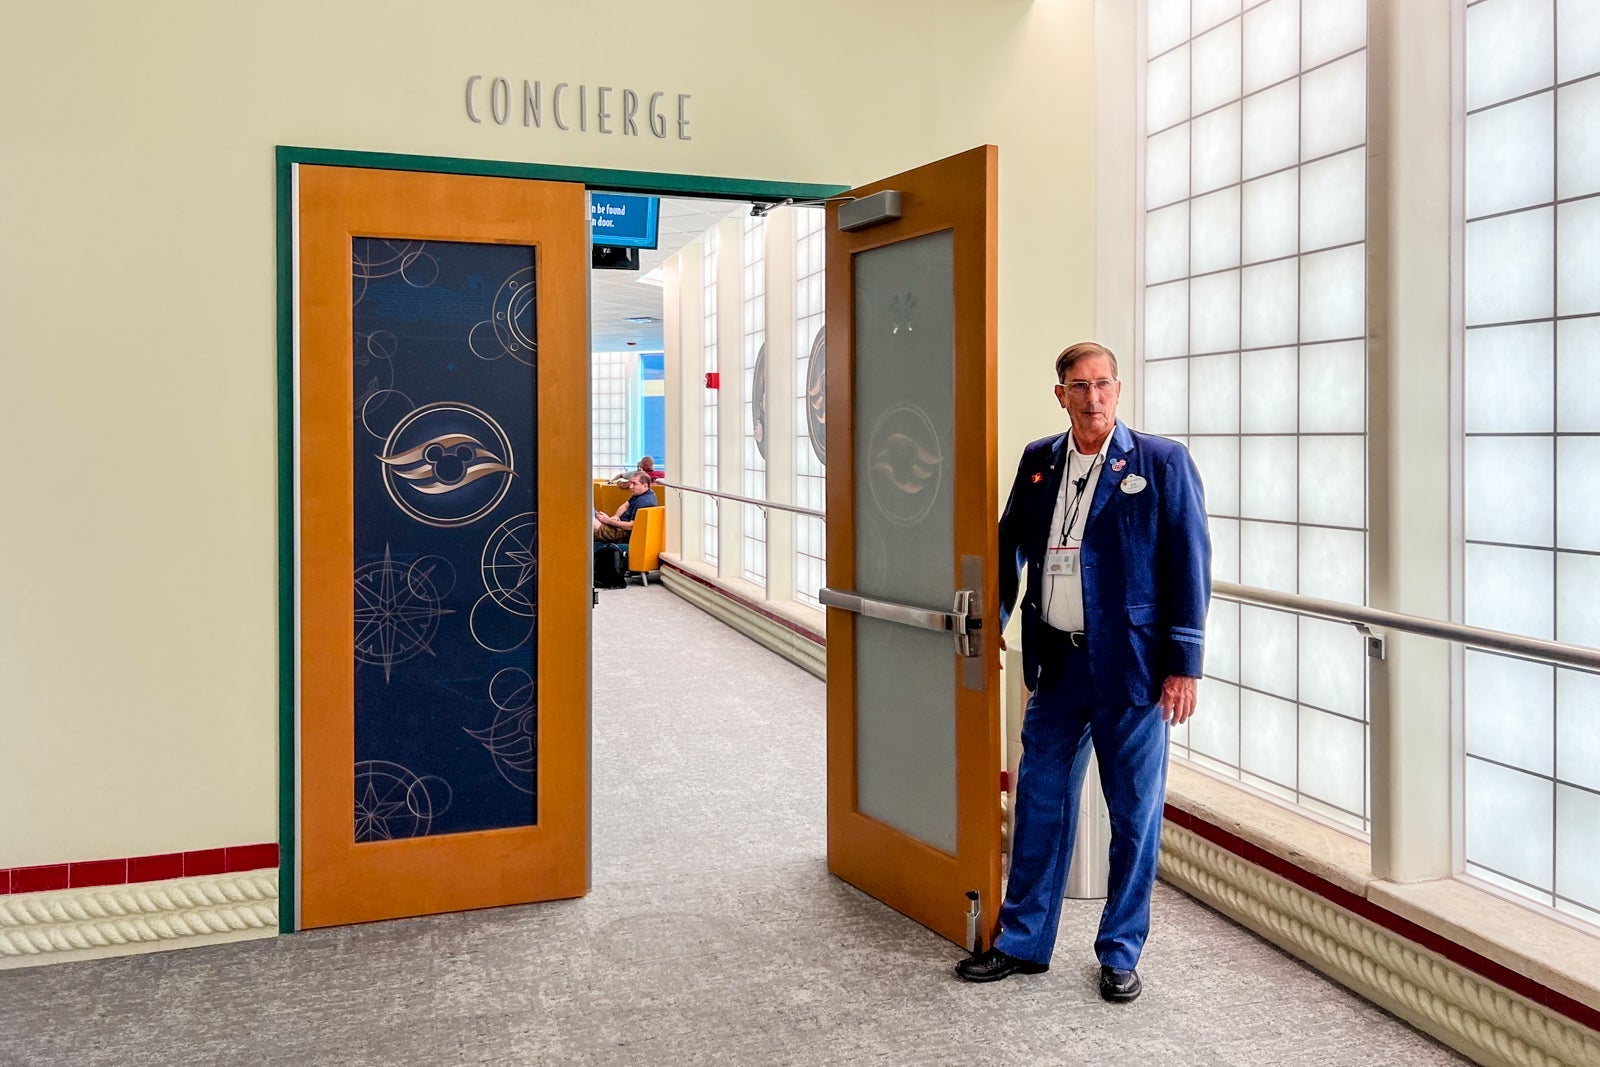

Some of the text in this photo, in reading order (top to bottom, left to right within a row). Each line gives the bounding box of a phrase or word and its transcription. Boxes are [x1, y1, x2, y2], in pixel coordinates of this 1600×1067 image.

[465, 75, 692, 140] CONCIERGE
[597, 203, 605, 214] be
[606, 204, 625, 215] found
[598, 216, 614, 227] door.
